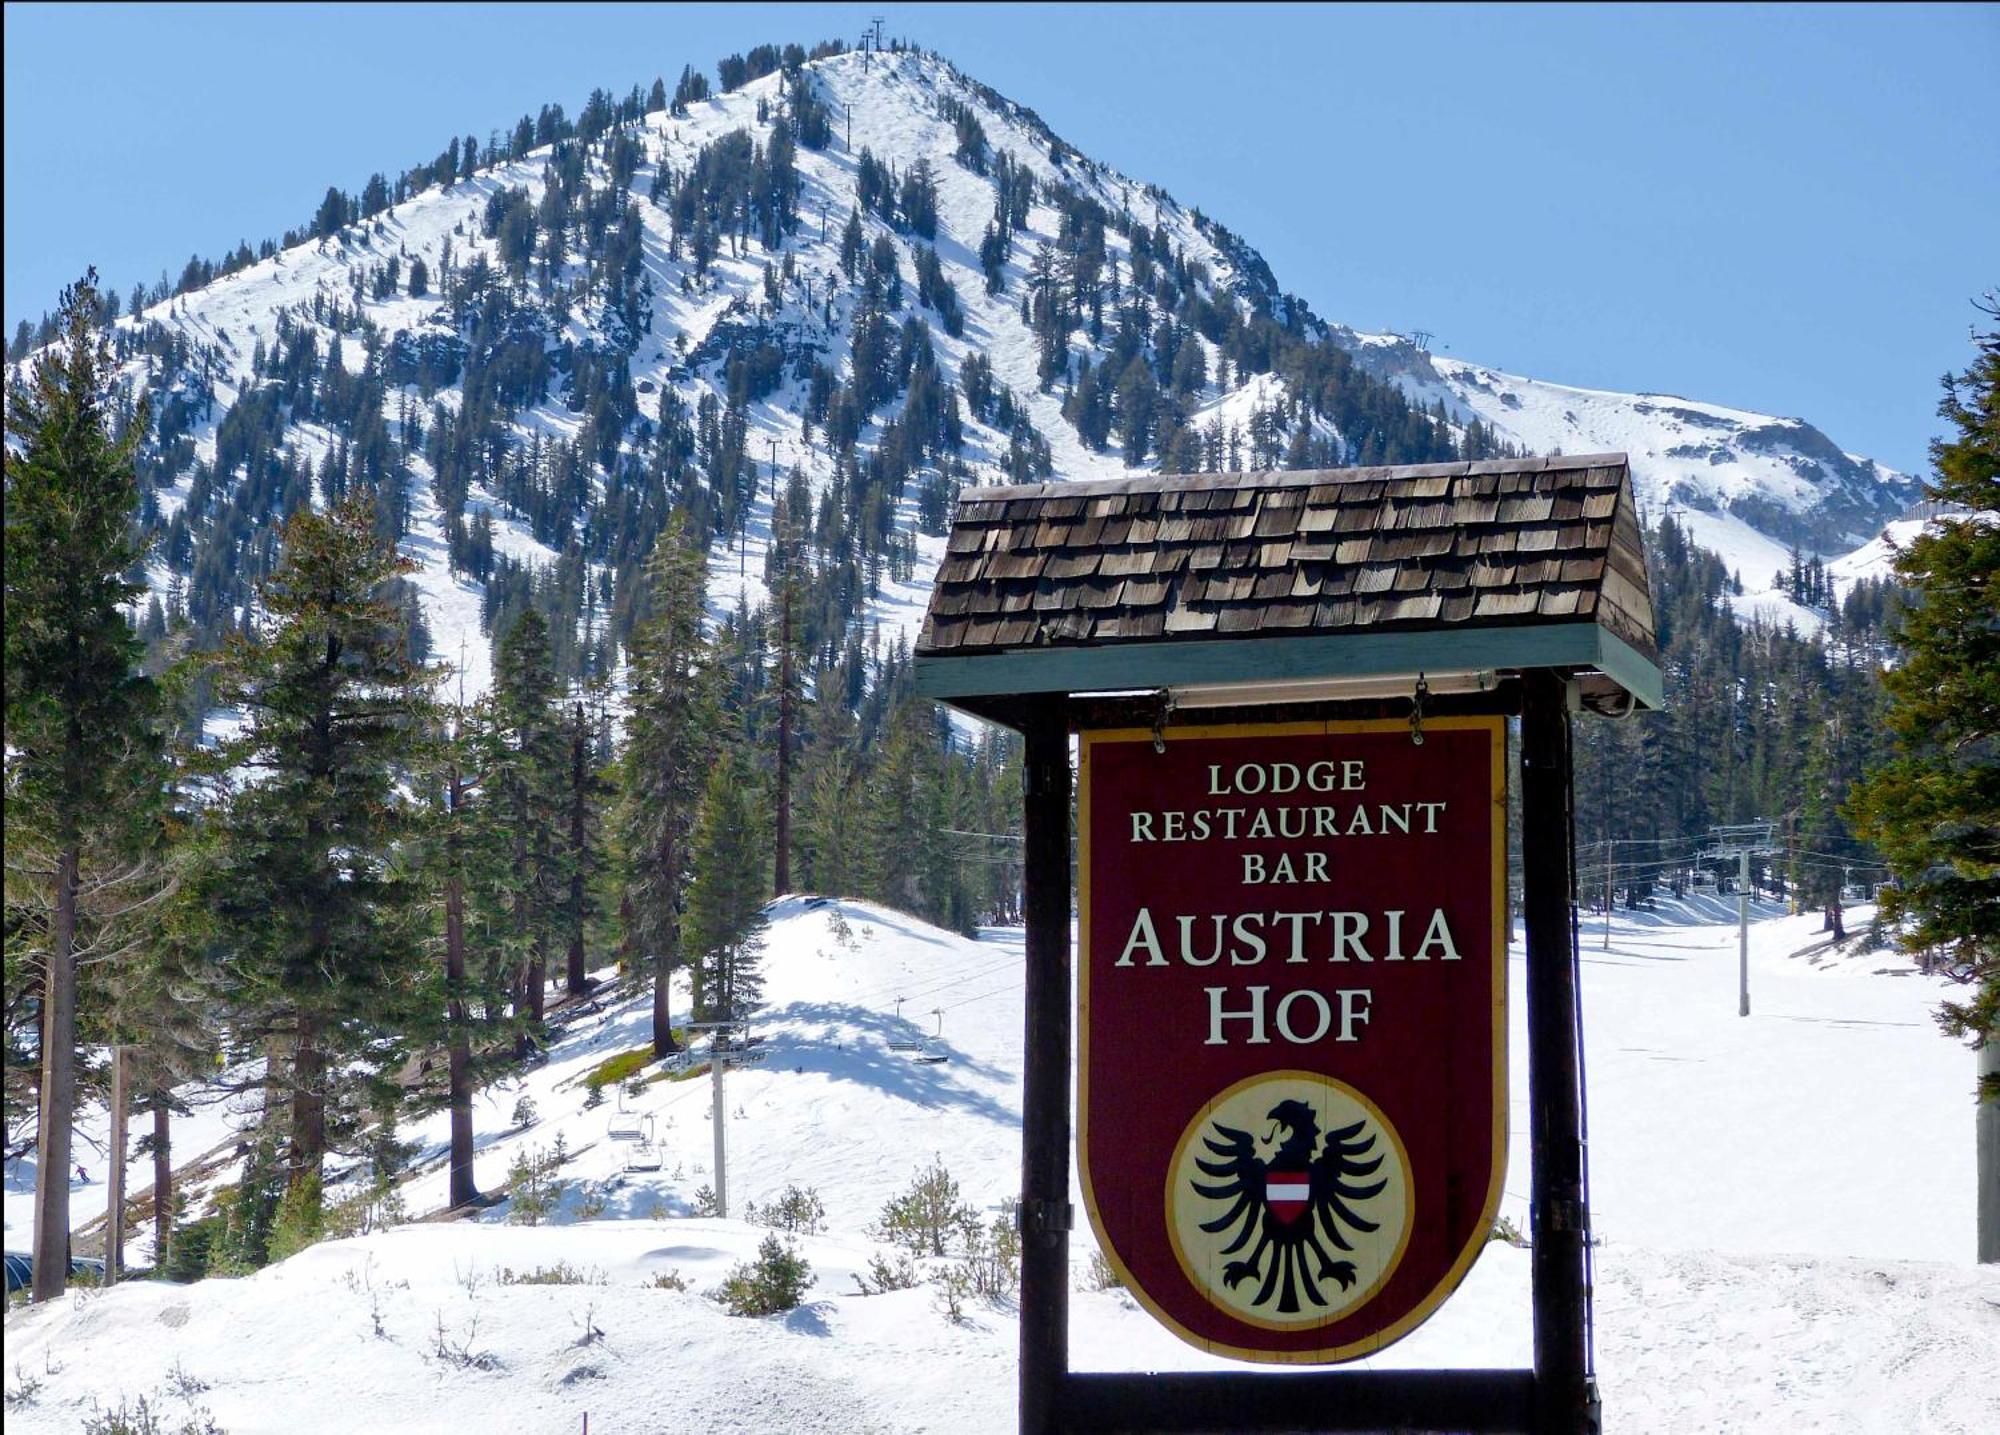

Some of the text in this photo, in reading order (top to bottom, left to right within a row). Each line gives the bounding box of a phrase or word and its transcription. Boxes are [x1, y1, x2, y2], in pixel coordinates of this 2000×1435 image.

[1208, 760, 1366, 795] LODGE
[1130, 802, 1446, 842] RESTAURANT
[1242, 852, 1331, 884] BAR
[1114, 907, 1462, 967] AUSTRIA
[1203, 986, 1372, 1045] HOF
